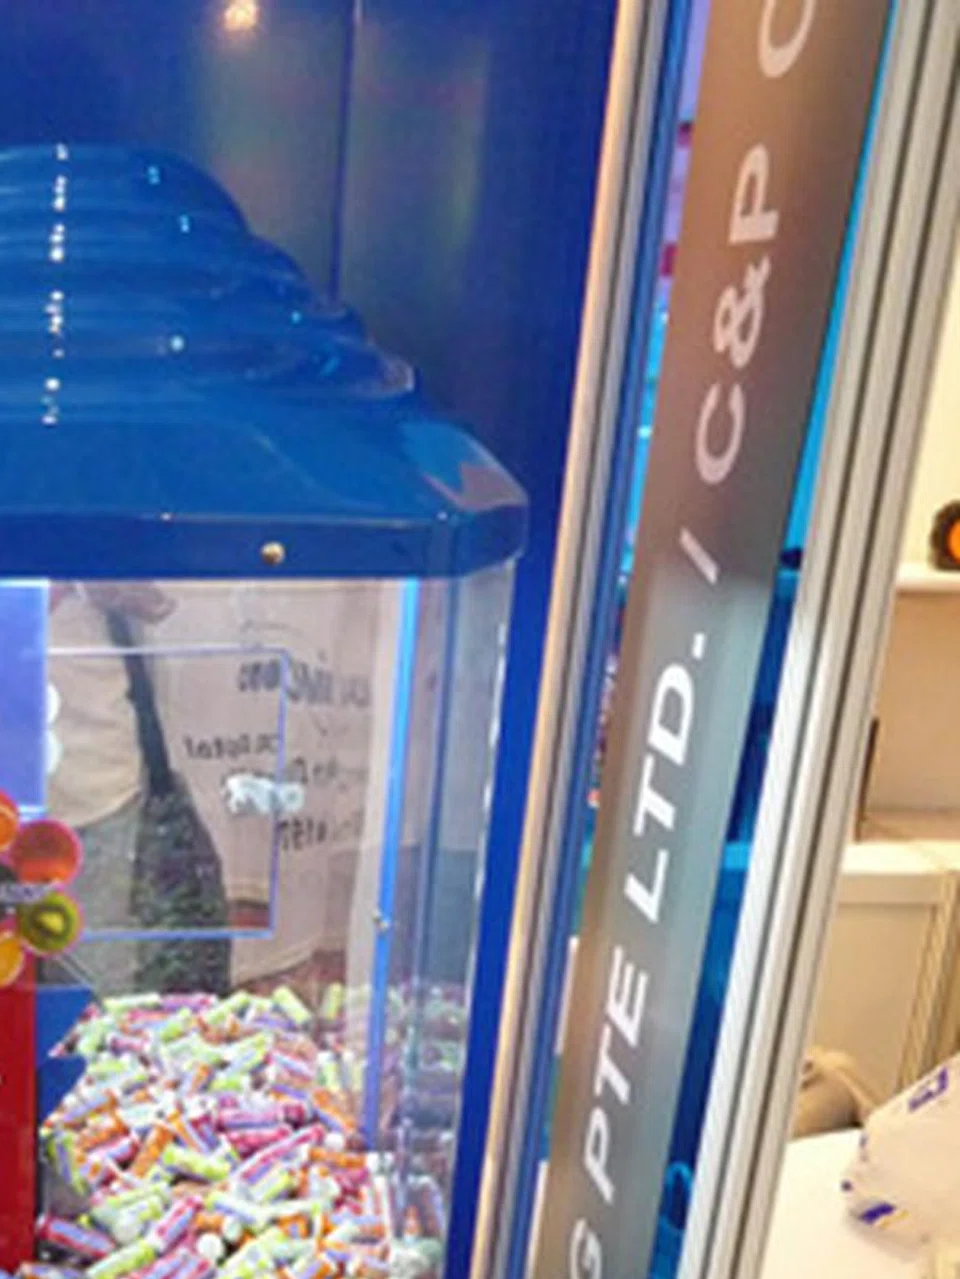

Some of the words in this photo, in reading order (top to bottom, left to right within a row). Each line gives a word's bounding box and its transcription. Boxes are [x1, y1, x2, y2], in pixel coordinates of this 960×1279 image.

[583, 944, 650, 1205] PTE
[623, 631, 707, 926] LTD.
[694, 143, 781, 485] C&P
